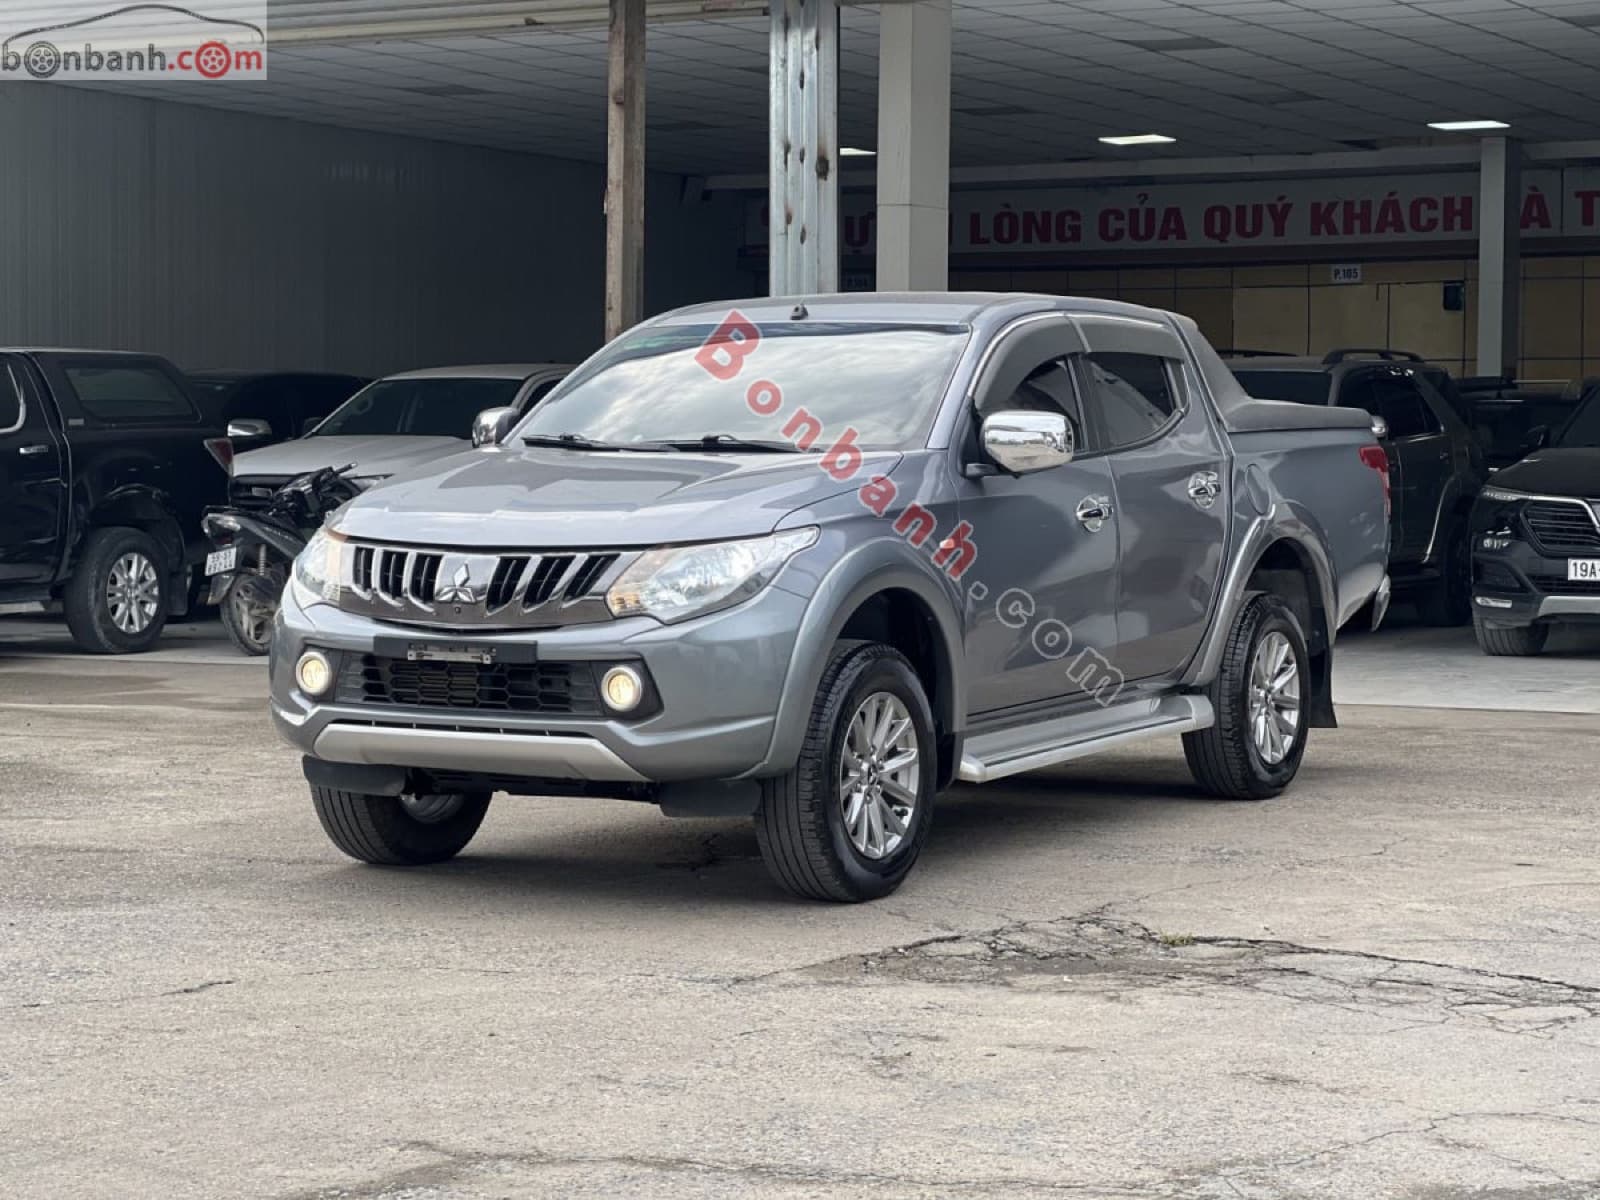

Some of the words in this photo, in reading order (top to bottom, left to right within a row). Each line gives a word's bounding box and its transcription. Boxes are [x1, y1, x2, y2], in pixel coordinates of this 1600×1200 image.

[969, 203, 1081, 245] LÒNG
[1098, 193, 1187, 242] CỦA
[1203, 194, 1293, 243] QUÝ
[1310, 191, 1473, 236] KHÁCH
